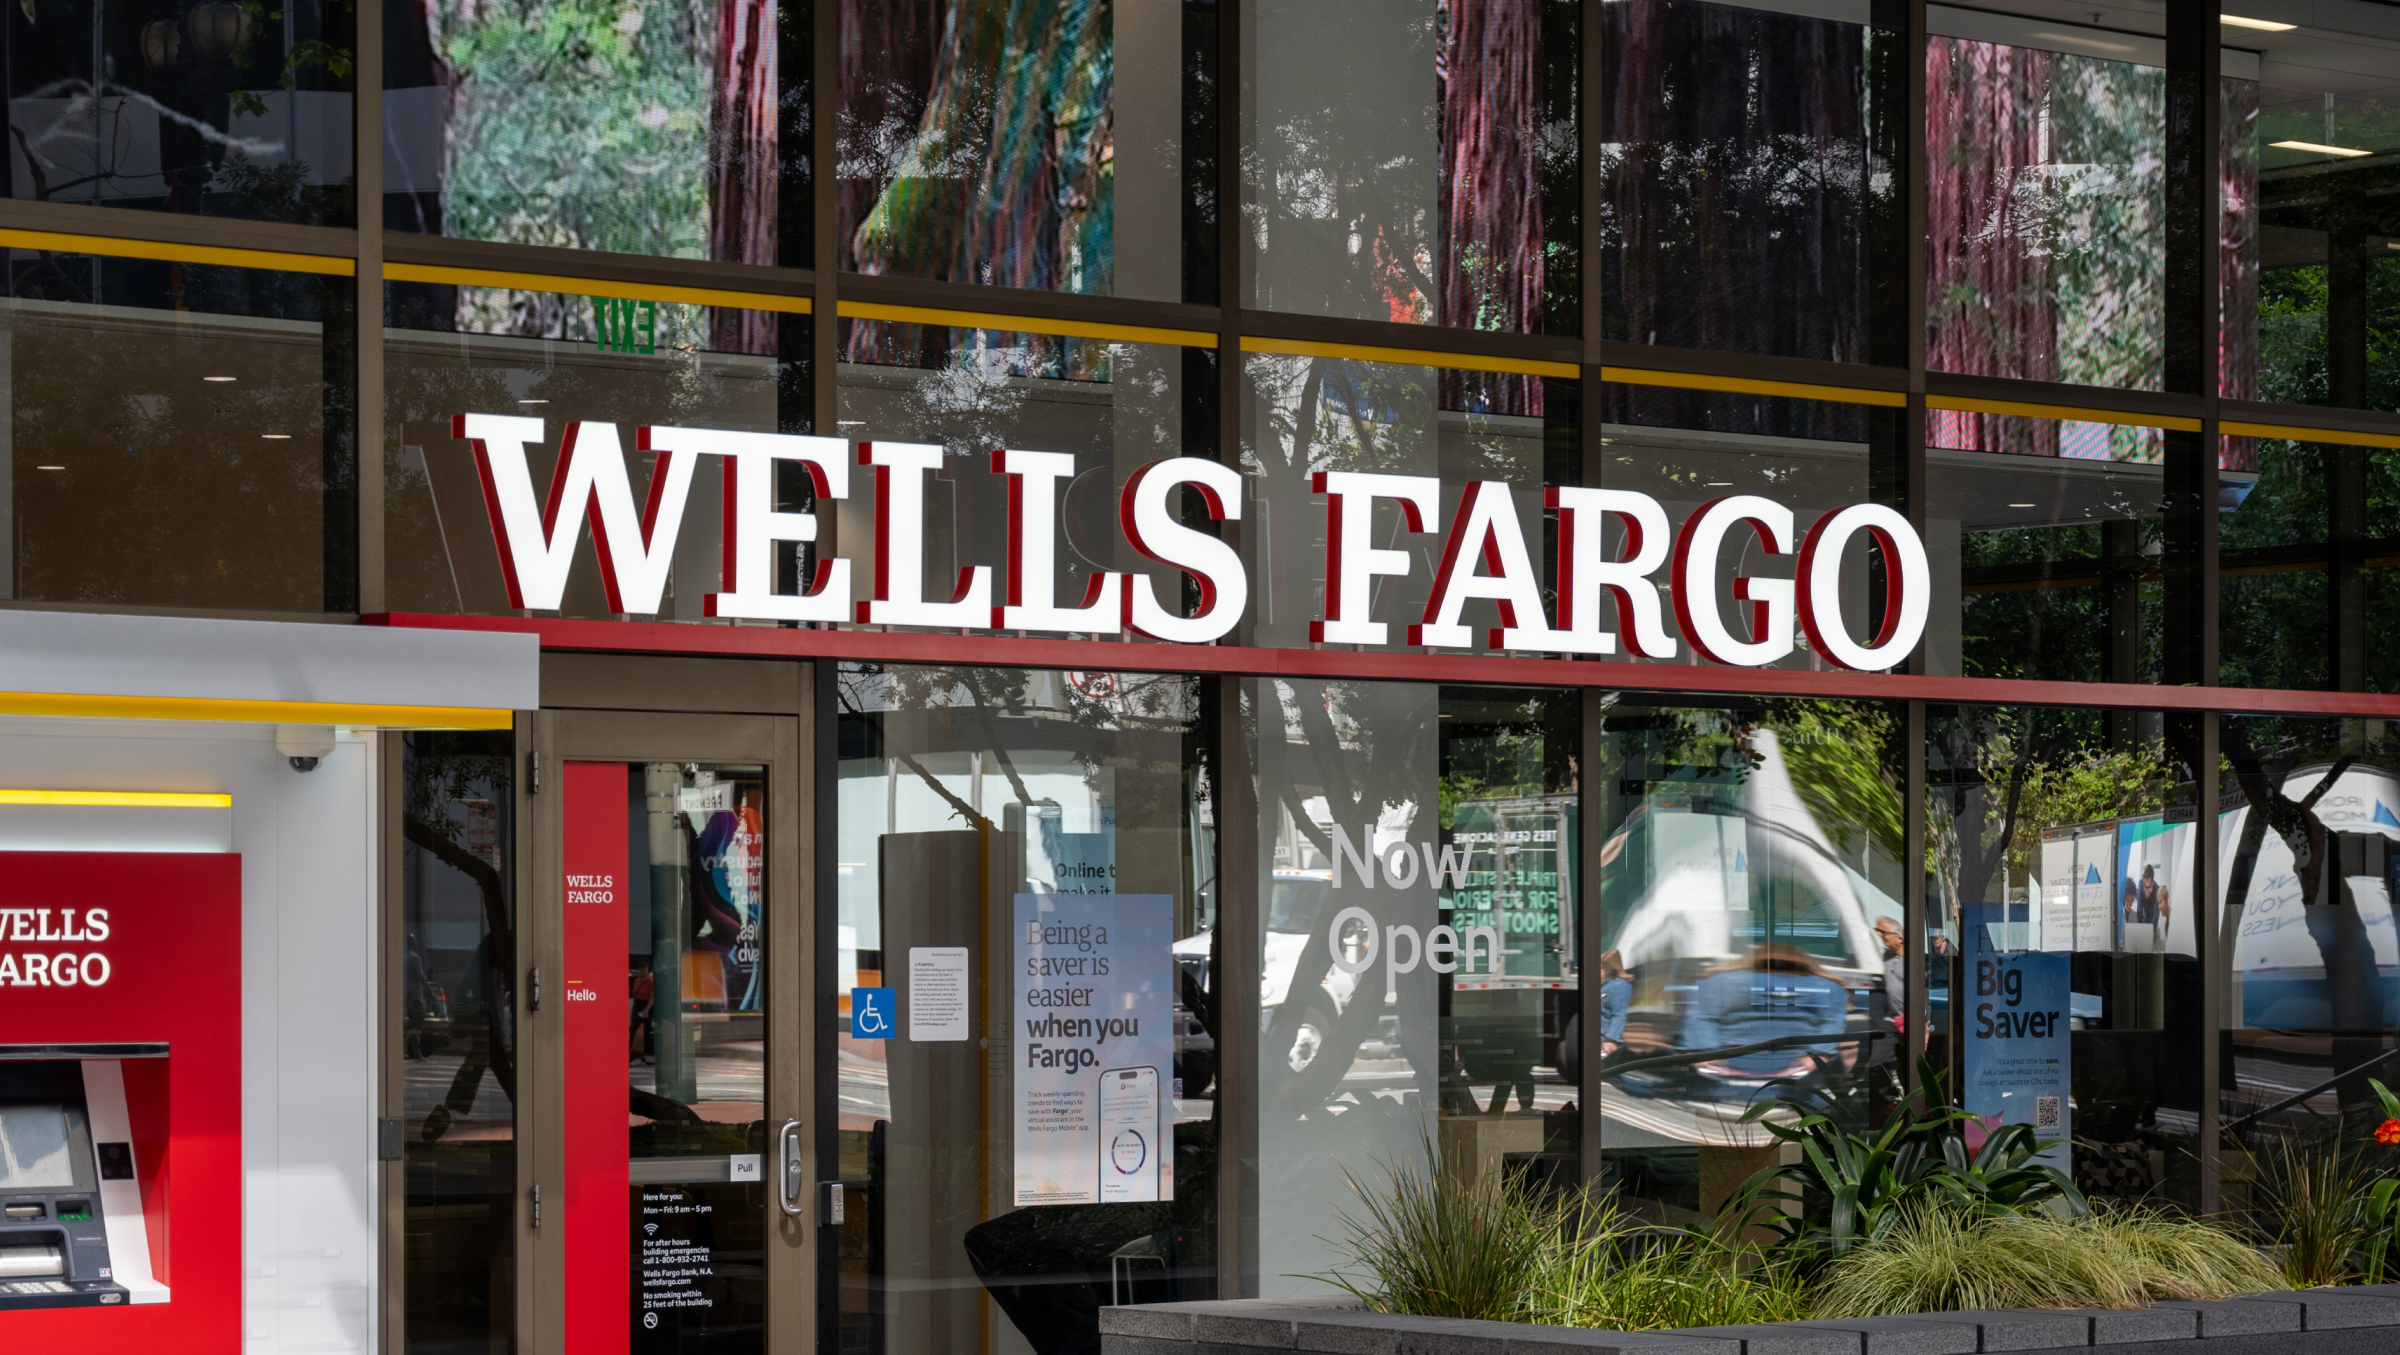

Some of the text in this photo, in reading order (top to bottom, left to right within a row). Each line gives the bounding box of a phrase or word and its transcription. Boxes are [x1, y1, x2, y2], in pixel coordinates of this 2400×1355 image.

[452, 412, 1931, 671] WELLS FARGO
[1331, 823, 1474, 890] Now
[1055, 862, 1105, 878] Online
[566, 876, 613, 888] WELLS
[568, 891, 614, 904] FARGO
[1026, 919, 1108, 952] Being a
[1328, 906, 1498, 993] Open
[0, 952, 110, 986] ARGO
[1027, 950, 1109, 976] saver is
[1976, 956, 2022, 1007] Big
[567, 988, 597, 1002] Hello
[1027, 981, 1094, 1008] easier
[1026, 1012, 1139, 1045] when you
[1975, 1002, 2060, 1040] Saver
[1028, 1043, 1100, 1075] Fargo.
[738, 1164, 753, 1172] Pull
[670, 1194, 683, 1202] you:
[643, 1246, 709, 1256] building emergencies
[655, 1255, 709, 1264] 1-800-932-2741
[662, 1270, 680, 1278] Fargo
[681, 1268, 698, 1276] Bank,
[643, 1279, 691, 1287] wellsfargo.com
[654, 1291, 681, 1299] smoking
[687, 1298, 712, 1306] building
